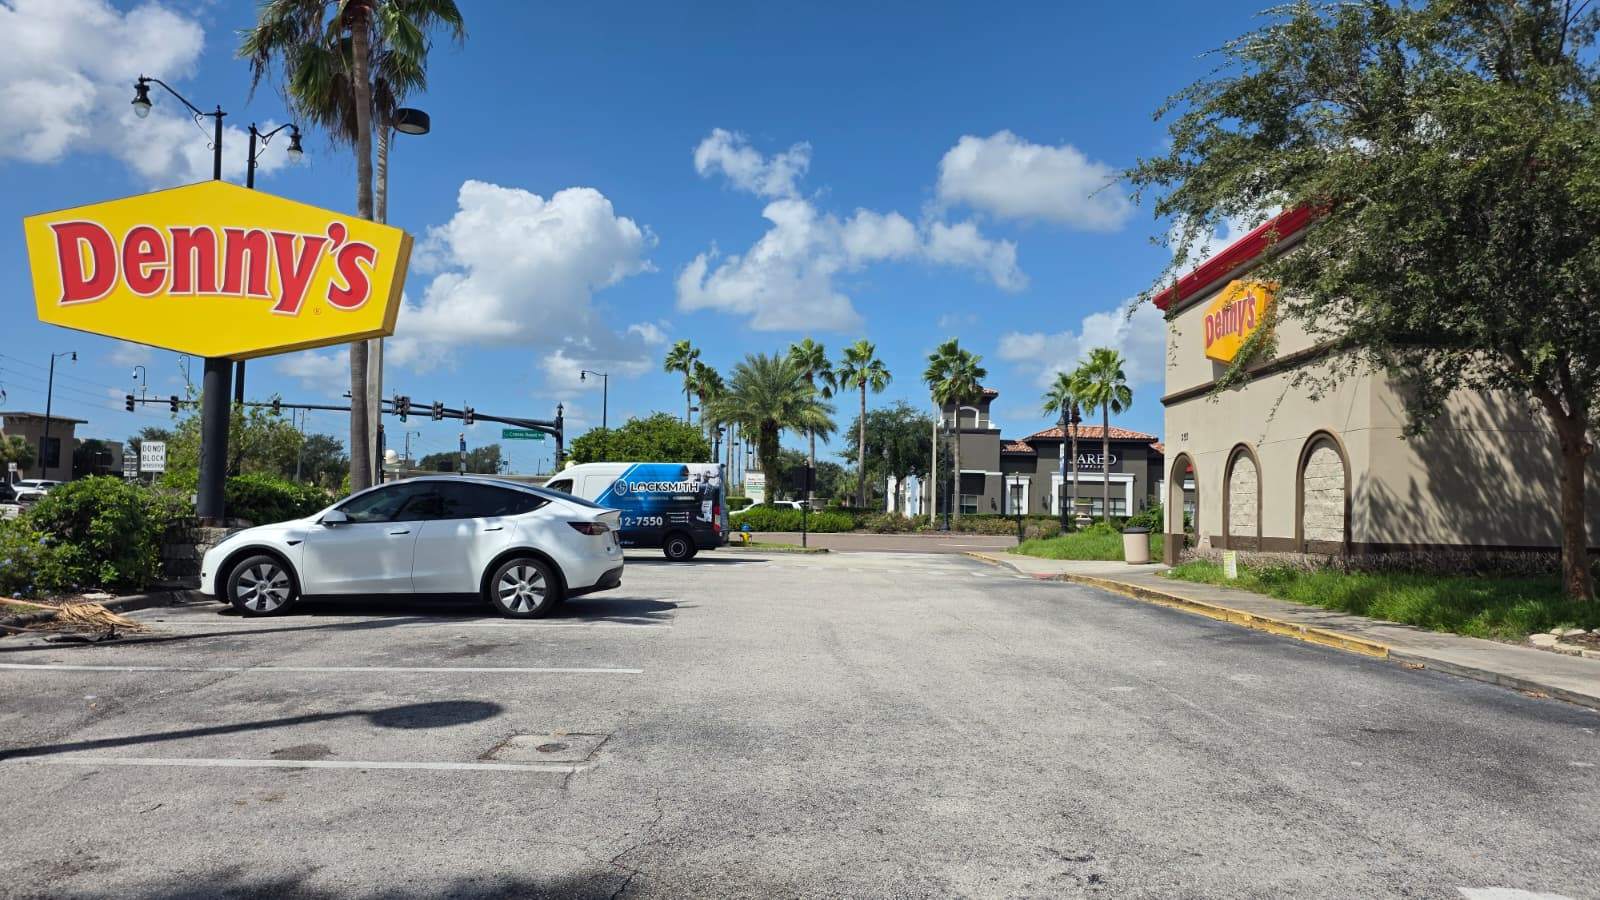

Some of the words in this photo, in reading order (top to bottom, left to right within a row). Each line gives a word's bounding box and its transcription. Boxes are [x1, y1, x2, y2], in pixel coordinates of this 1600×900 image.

[48, 220, 378, 315] Denny's
[1205, 289, 1256, 348] Denny's
[630, 481, 699, 493] LOCKSMITH
